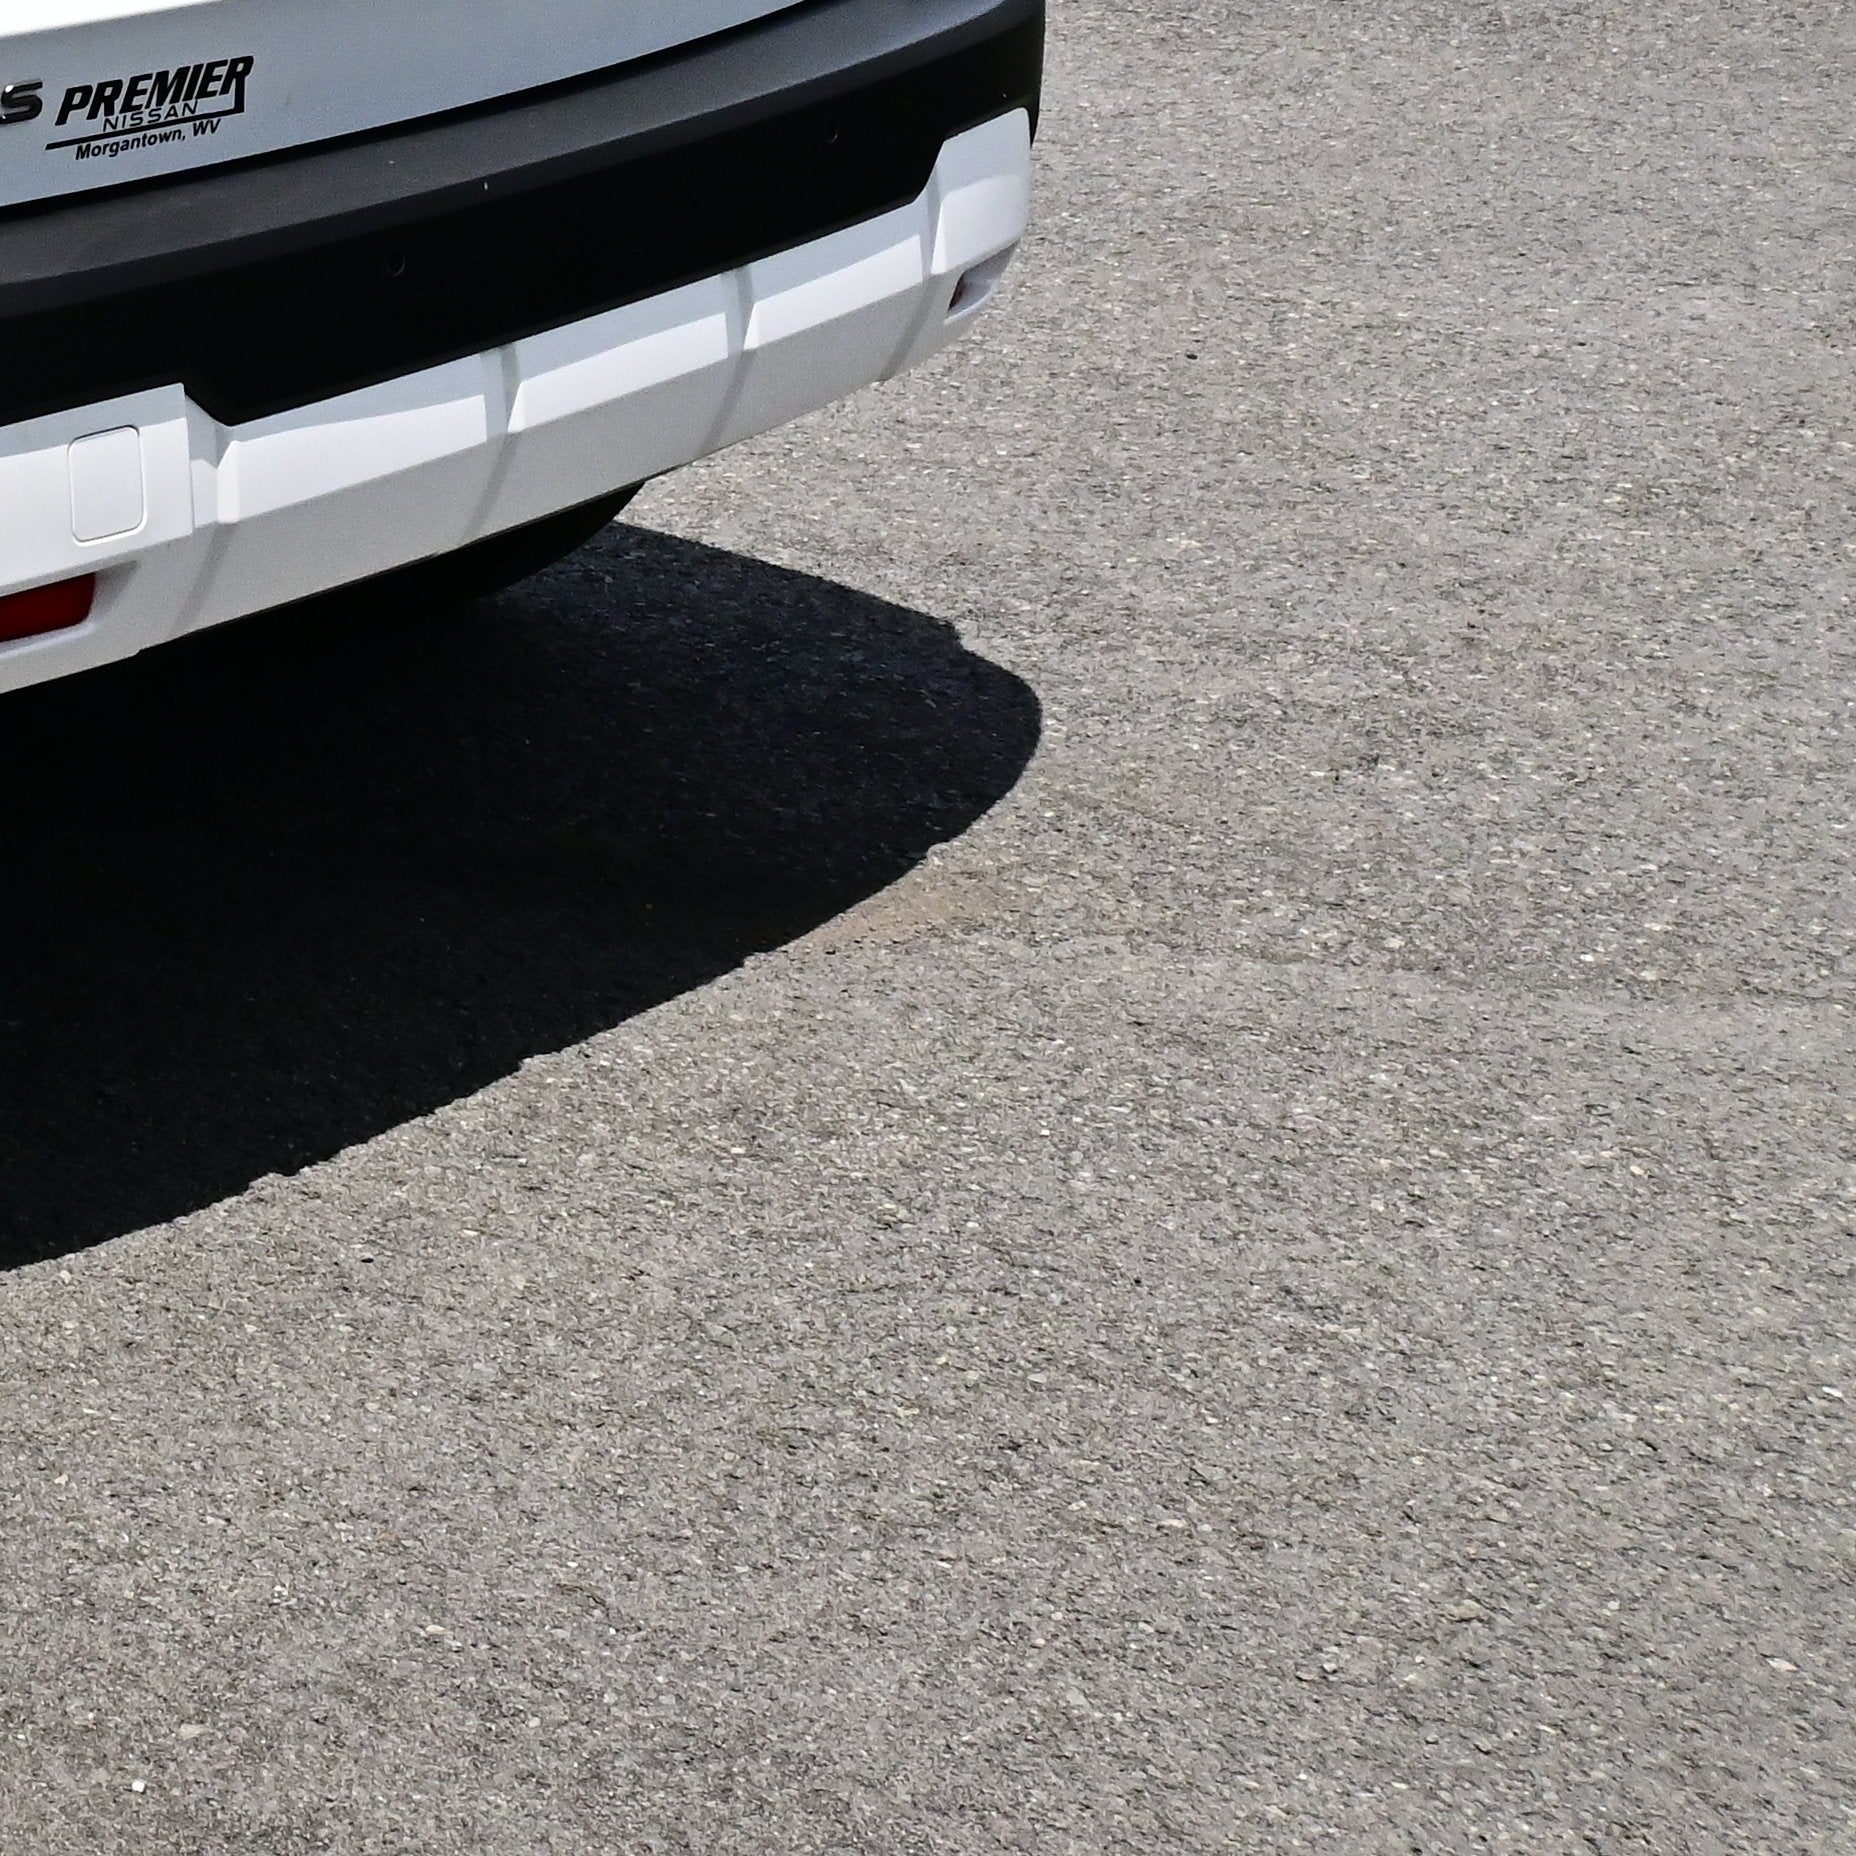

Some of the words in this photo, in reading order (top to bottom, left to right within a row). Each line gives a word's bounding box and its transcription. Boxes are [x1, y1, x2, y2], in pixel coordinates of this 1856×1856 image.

[54, 55, 255, 127] PREMIER
[102, 99, 199, 133] NISSAN
[74, 129, 186, 161] Morgantown,
[191, 118, 222, 137] WV
